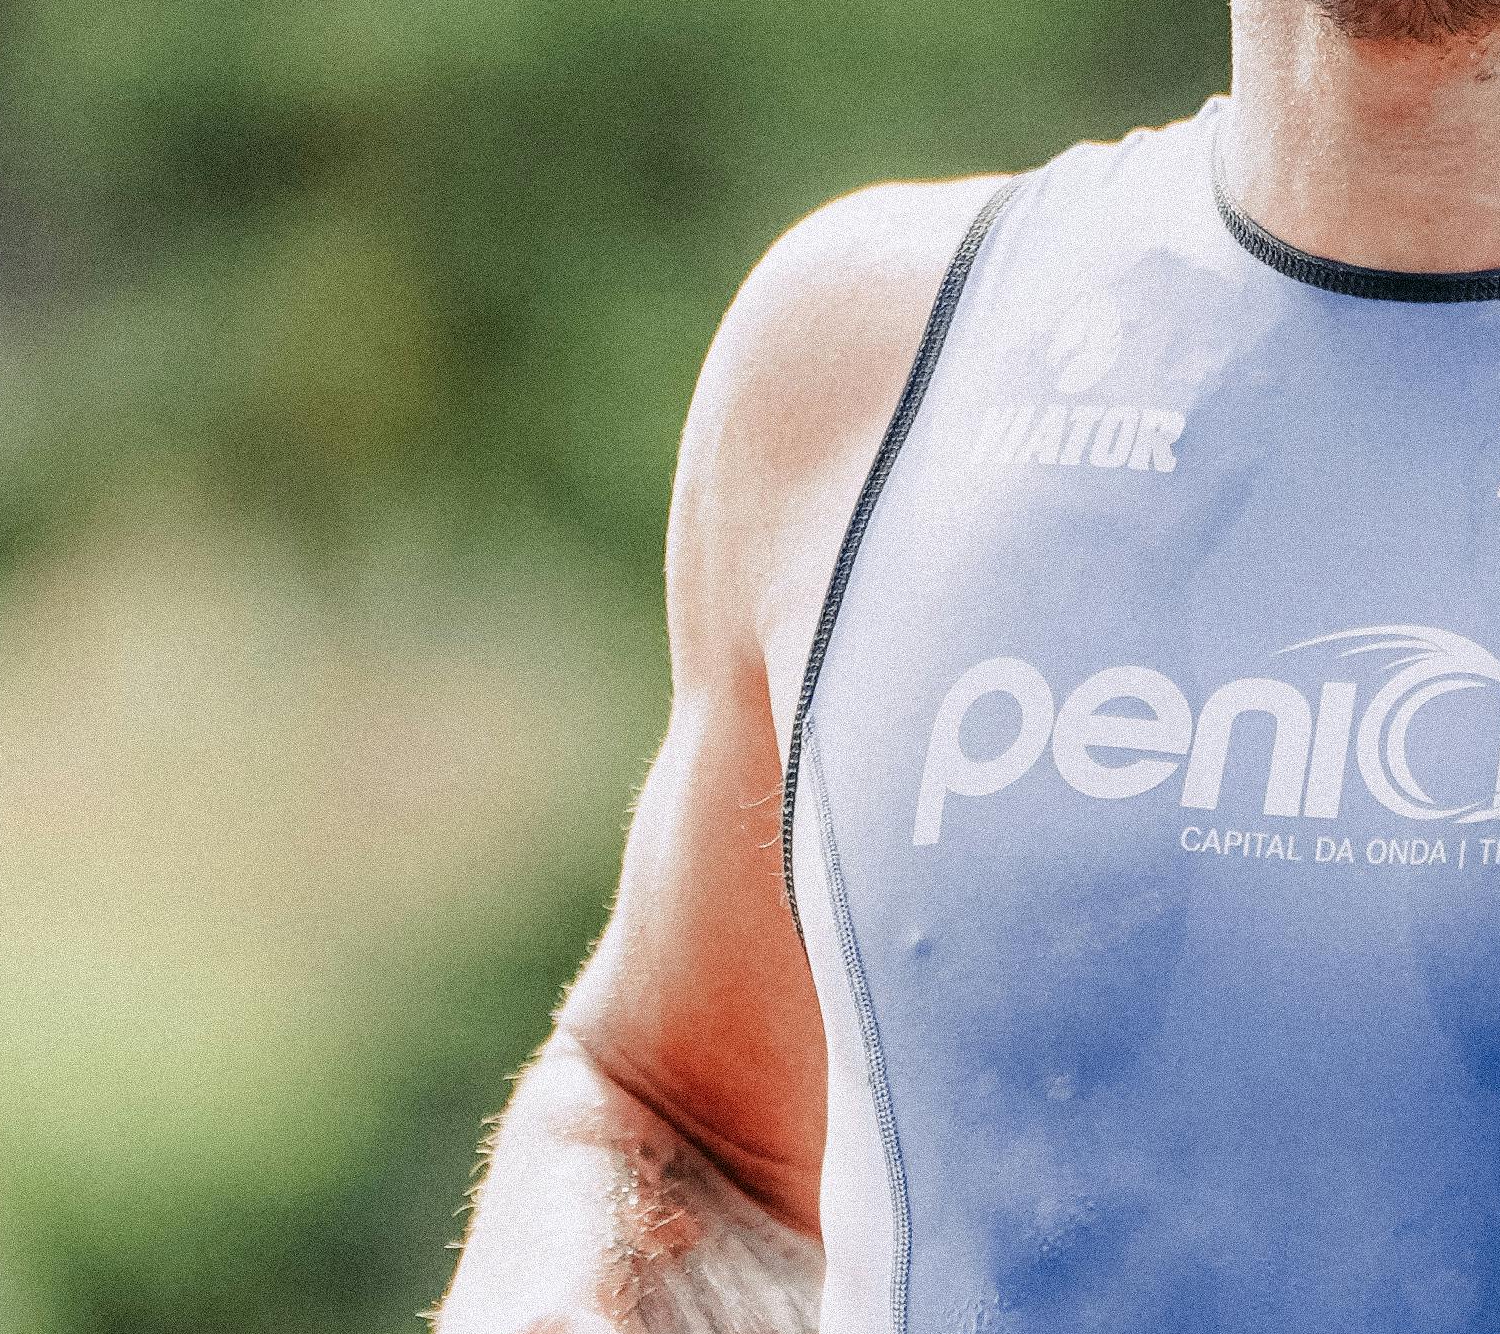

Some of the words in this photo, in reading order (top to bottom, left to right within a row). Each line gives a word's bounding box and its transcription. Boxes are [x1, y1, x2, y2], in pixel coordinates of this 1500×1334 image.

[1179, 826, 1302, 862] CAPITAL
[1315, 838, 1354, 864] DA
[1367, 838, 1448, 867] ONDA
